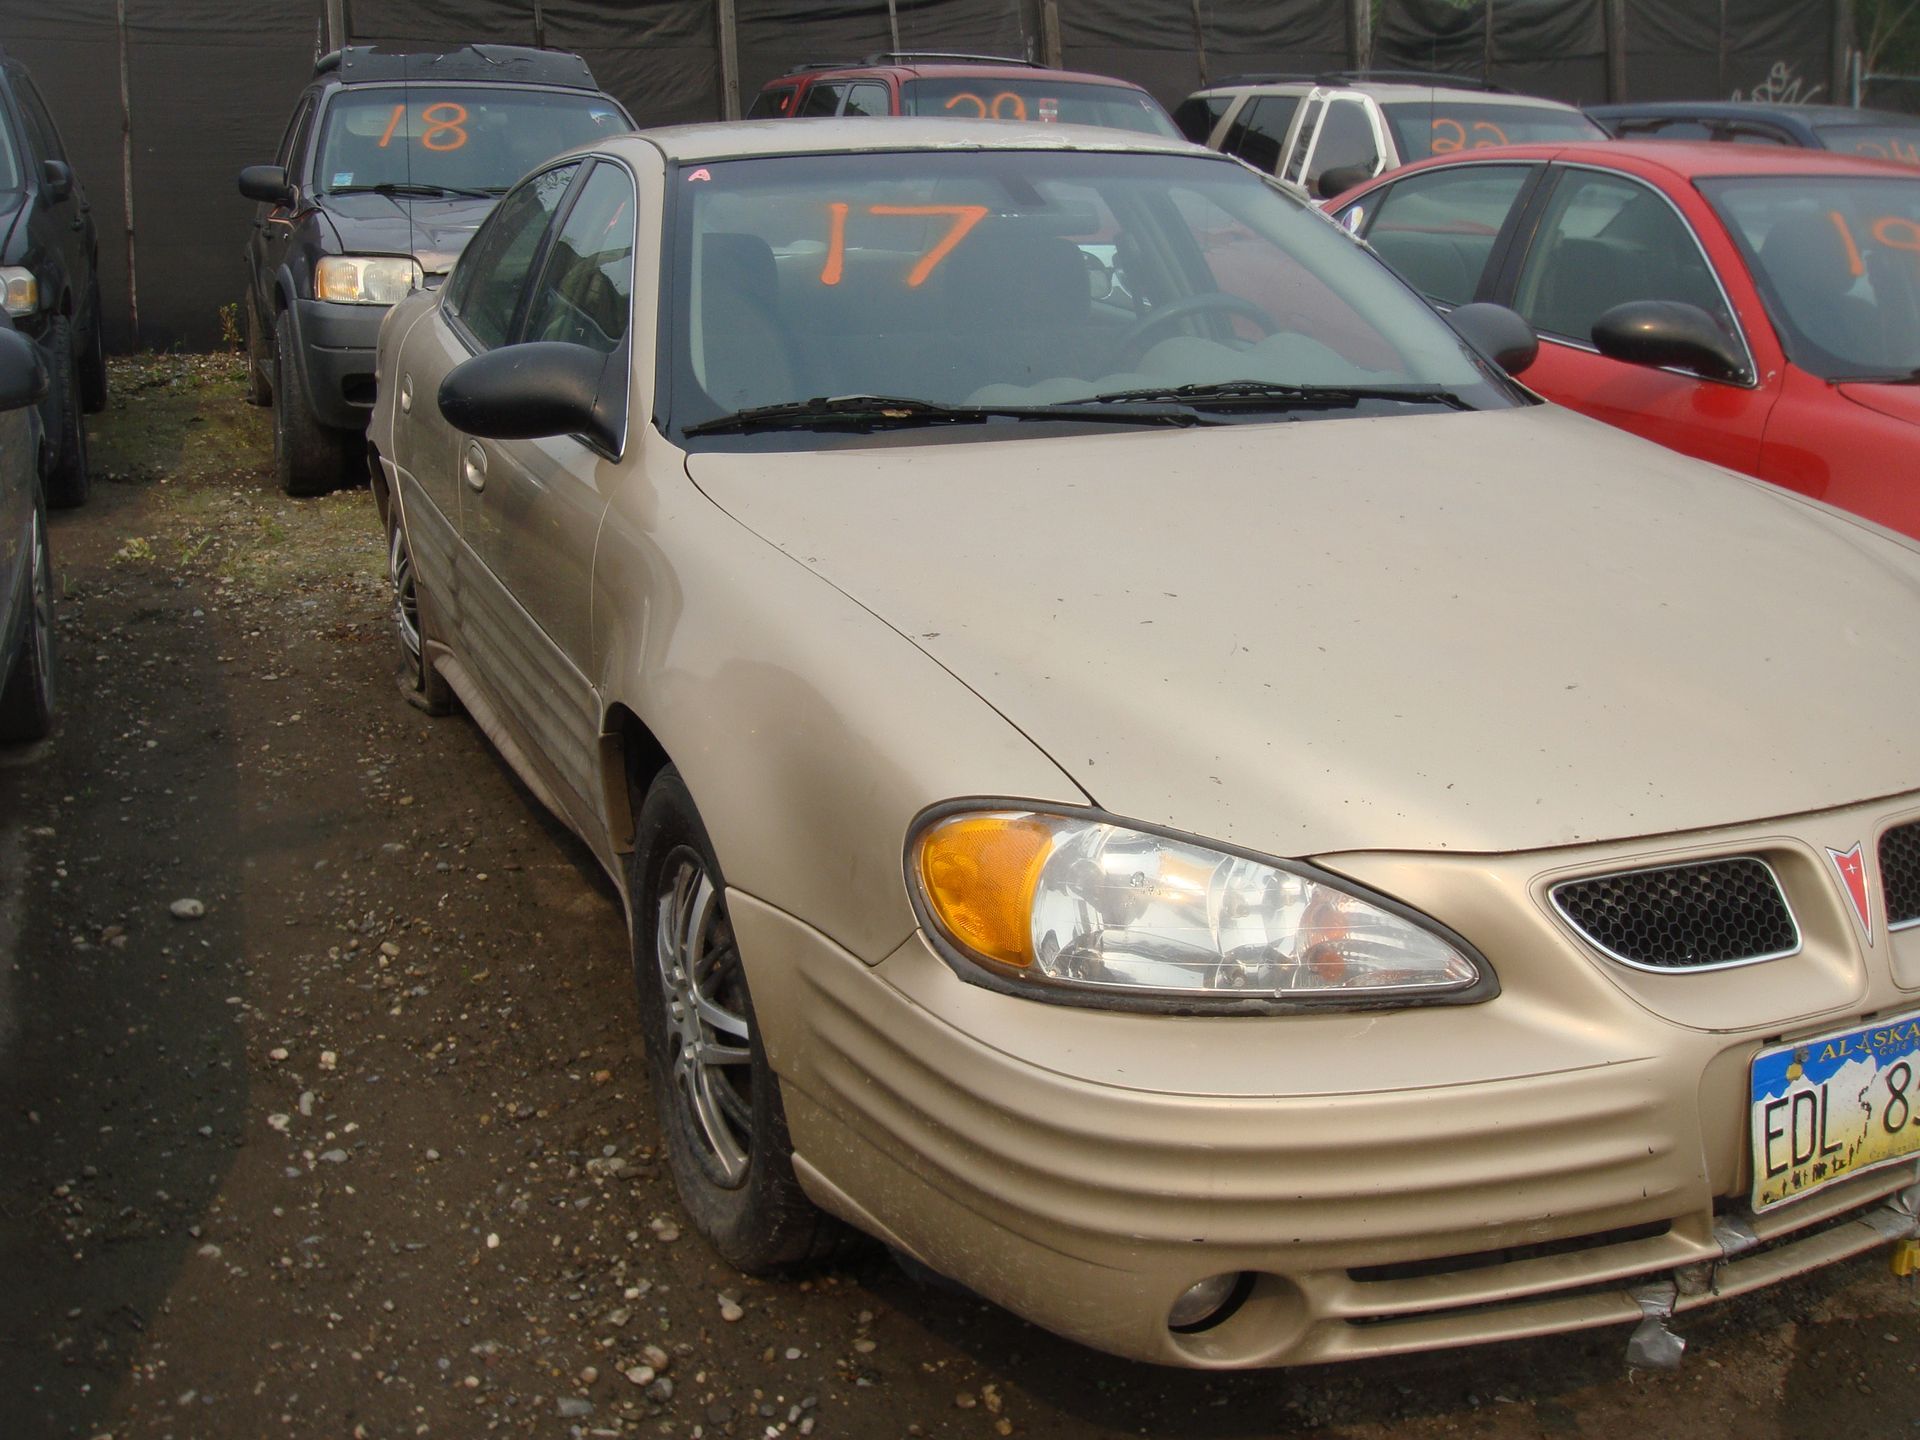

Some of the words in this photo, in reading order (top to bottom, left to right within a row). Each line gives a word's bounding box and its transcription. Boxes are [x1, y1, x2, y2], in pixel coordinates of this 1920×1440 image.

[377, 102, 468, 151] 18
[820, 203, 989, 287] 17
[1818, 1022, 1920, 1063] ALASKA
[1764, 1082, 1843, 1178] EDL
